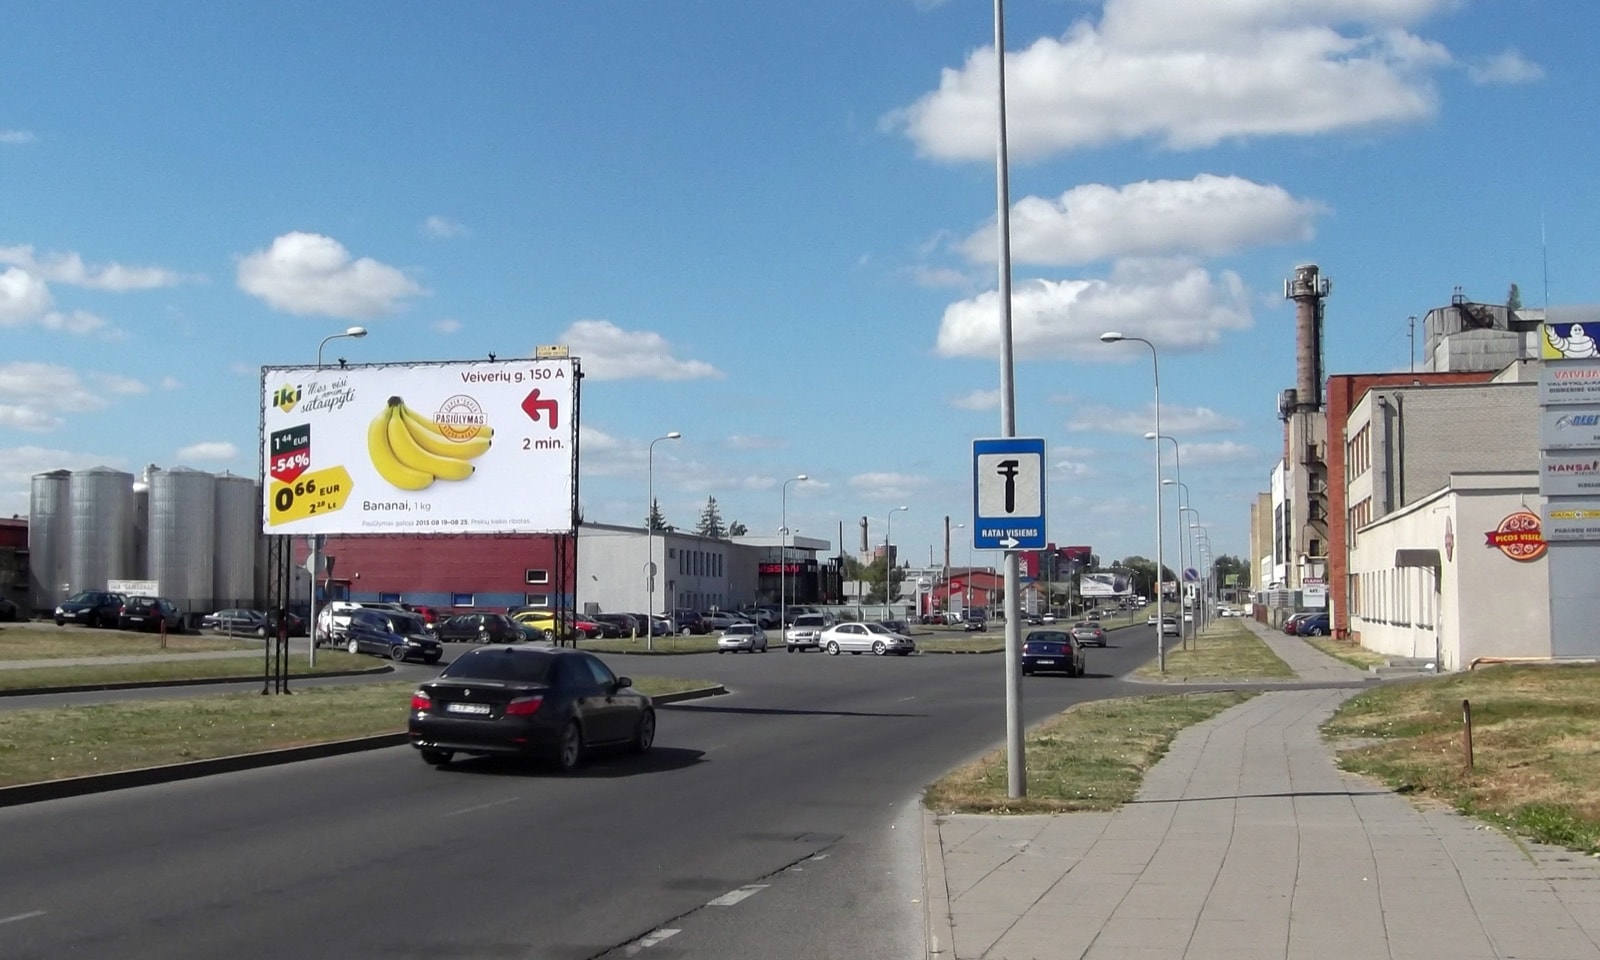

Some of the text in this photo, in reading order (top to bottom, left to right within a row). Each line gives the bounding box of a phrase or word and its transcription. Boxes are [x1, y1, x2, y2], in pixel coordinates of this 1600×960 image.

[461, 368, 565, 383] Veiverių g. 150 A
[273, 384, 302, 407] iki
[293, 436, 308, 446] EUR
[522, 436, 564, 450] 2 min.
[271, 452, 309, 472] -54%
[320, 484, 340, 496] EUR
[362, 500, 431, 512] Bananai, 1 kg
[982, 529, 1038, 537] RATAI VISIEMS
[1495, 534, 1518, 542] PICOS
